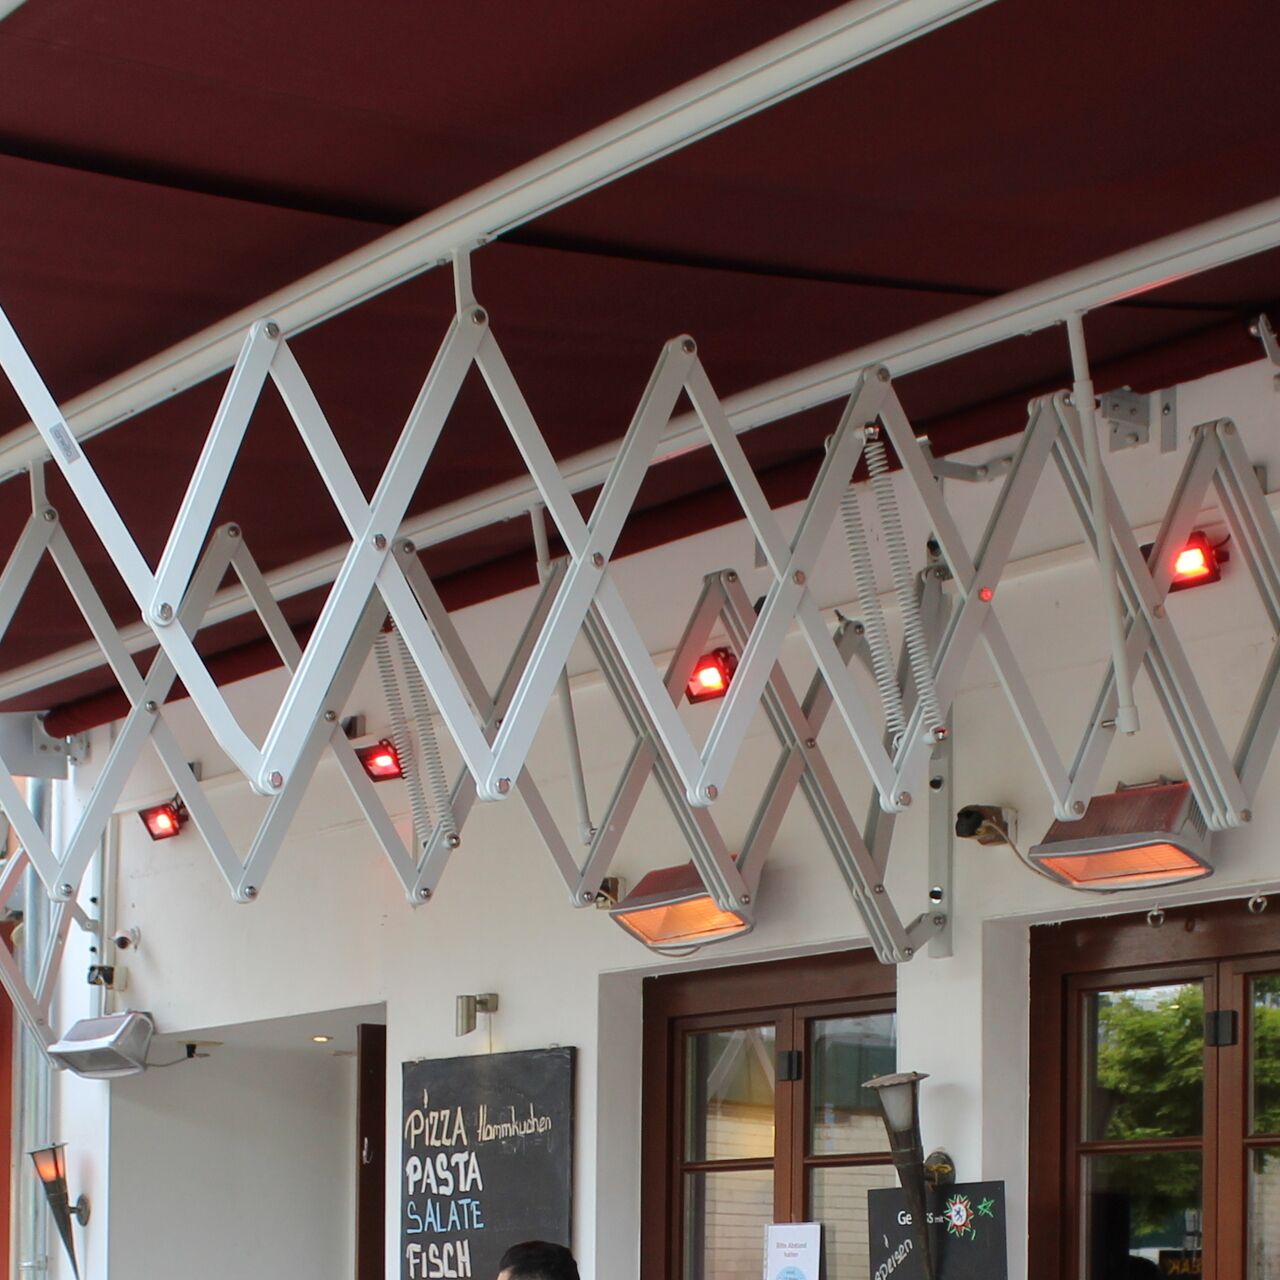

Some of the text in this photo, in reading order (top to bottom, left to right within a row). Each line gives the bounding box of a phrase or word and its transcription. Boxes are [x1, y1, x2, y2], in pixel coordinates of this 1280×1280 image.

[405, 1151, 484, 1197] PASTA
[407, 1198, 485, 1235] SALATE
[406, 1240, 472, 1280] FISCH
